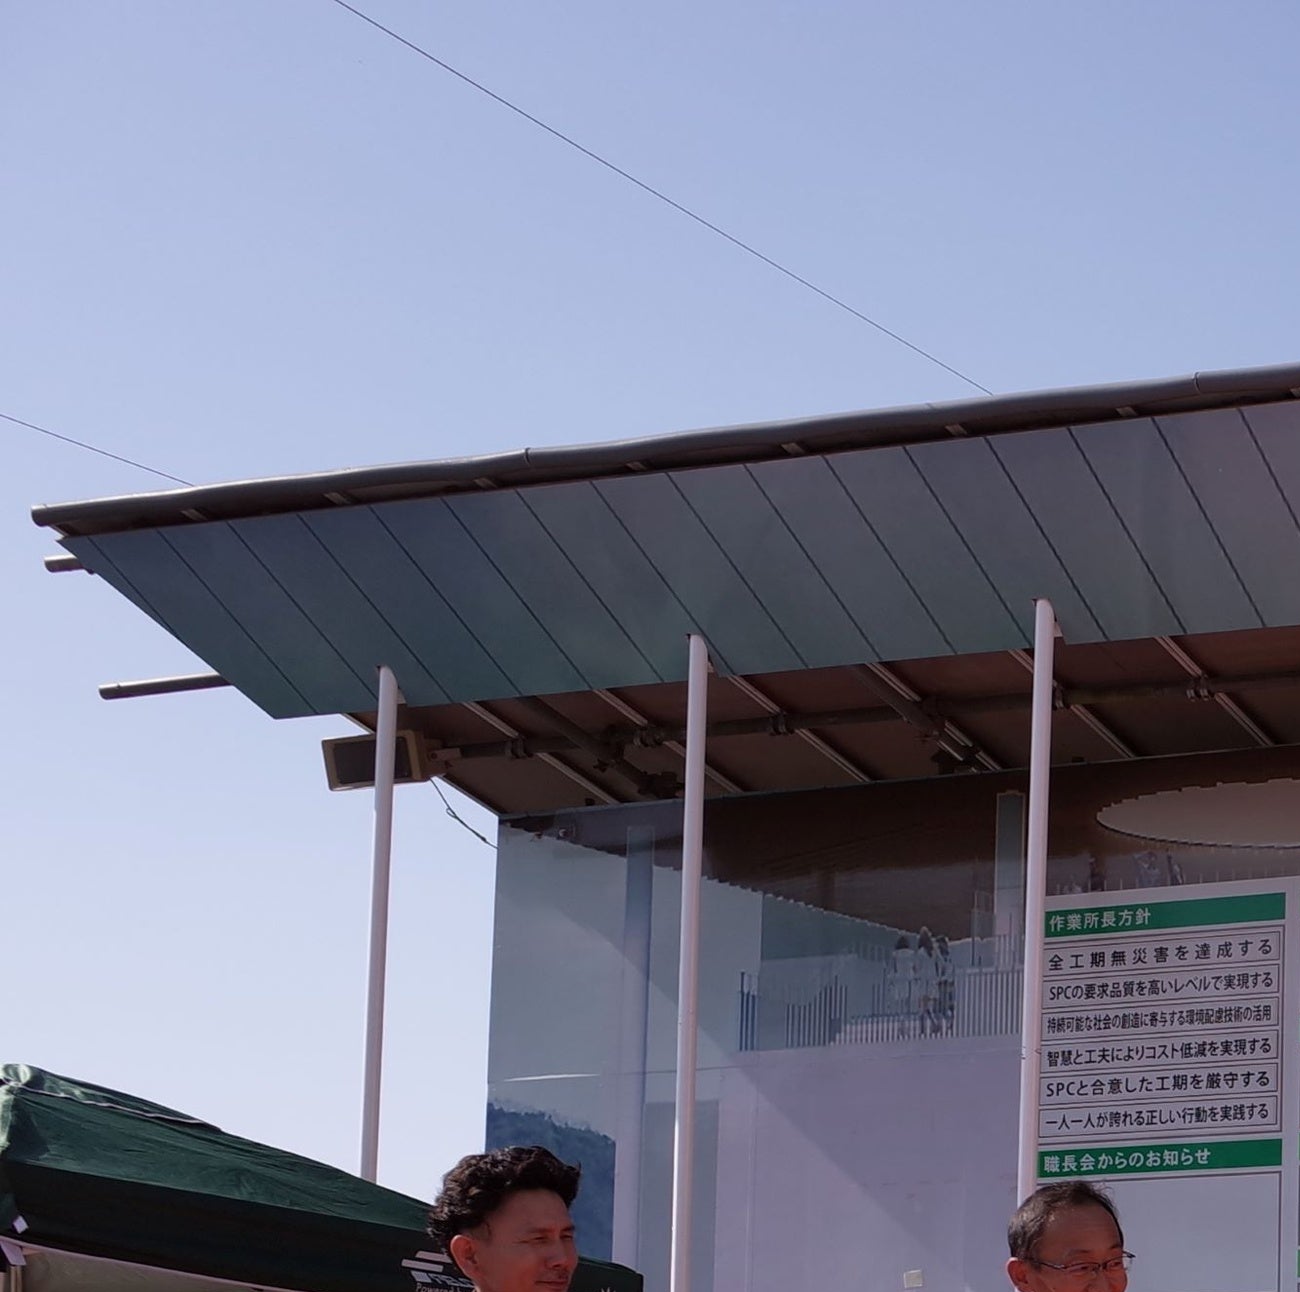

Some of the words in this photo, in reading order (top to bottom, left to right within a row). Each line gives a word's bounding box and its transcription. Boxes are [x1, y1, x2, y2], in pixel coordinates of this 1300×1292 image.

[1049, 907, 1151, 932] 作業所長方針
[1048, 939, 1273, 971] 全工期無災害を達成する
[1049, 971, 1274, 1001] SPCの要求品質を高いレベルで実現する
[1046, 1070, 1270, 1097] SPCと合意した工期を厳守する
[1043, 1148, 1211, 1173] 職長会からのお知らせ
